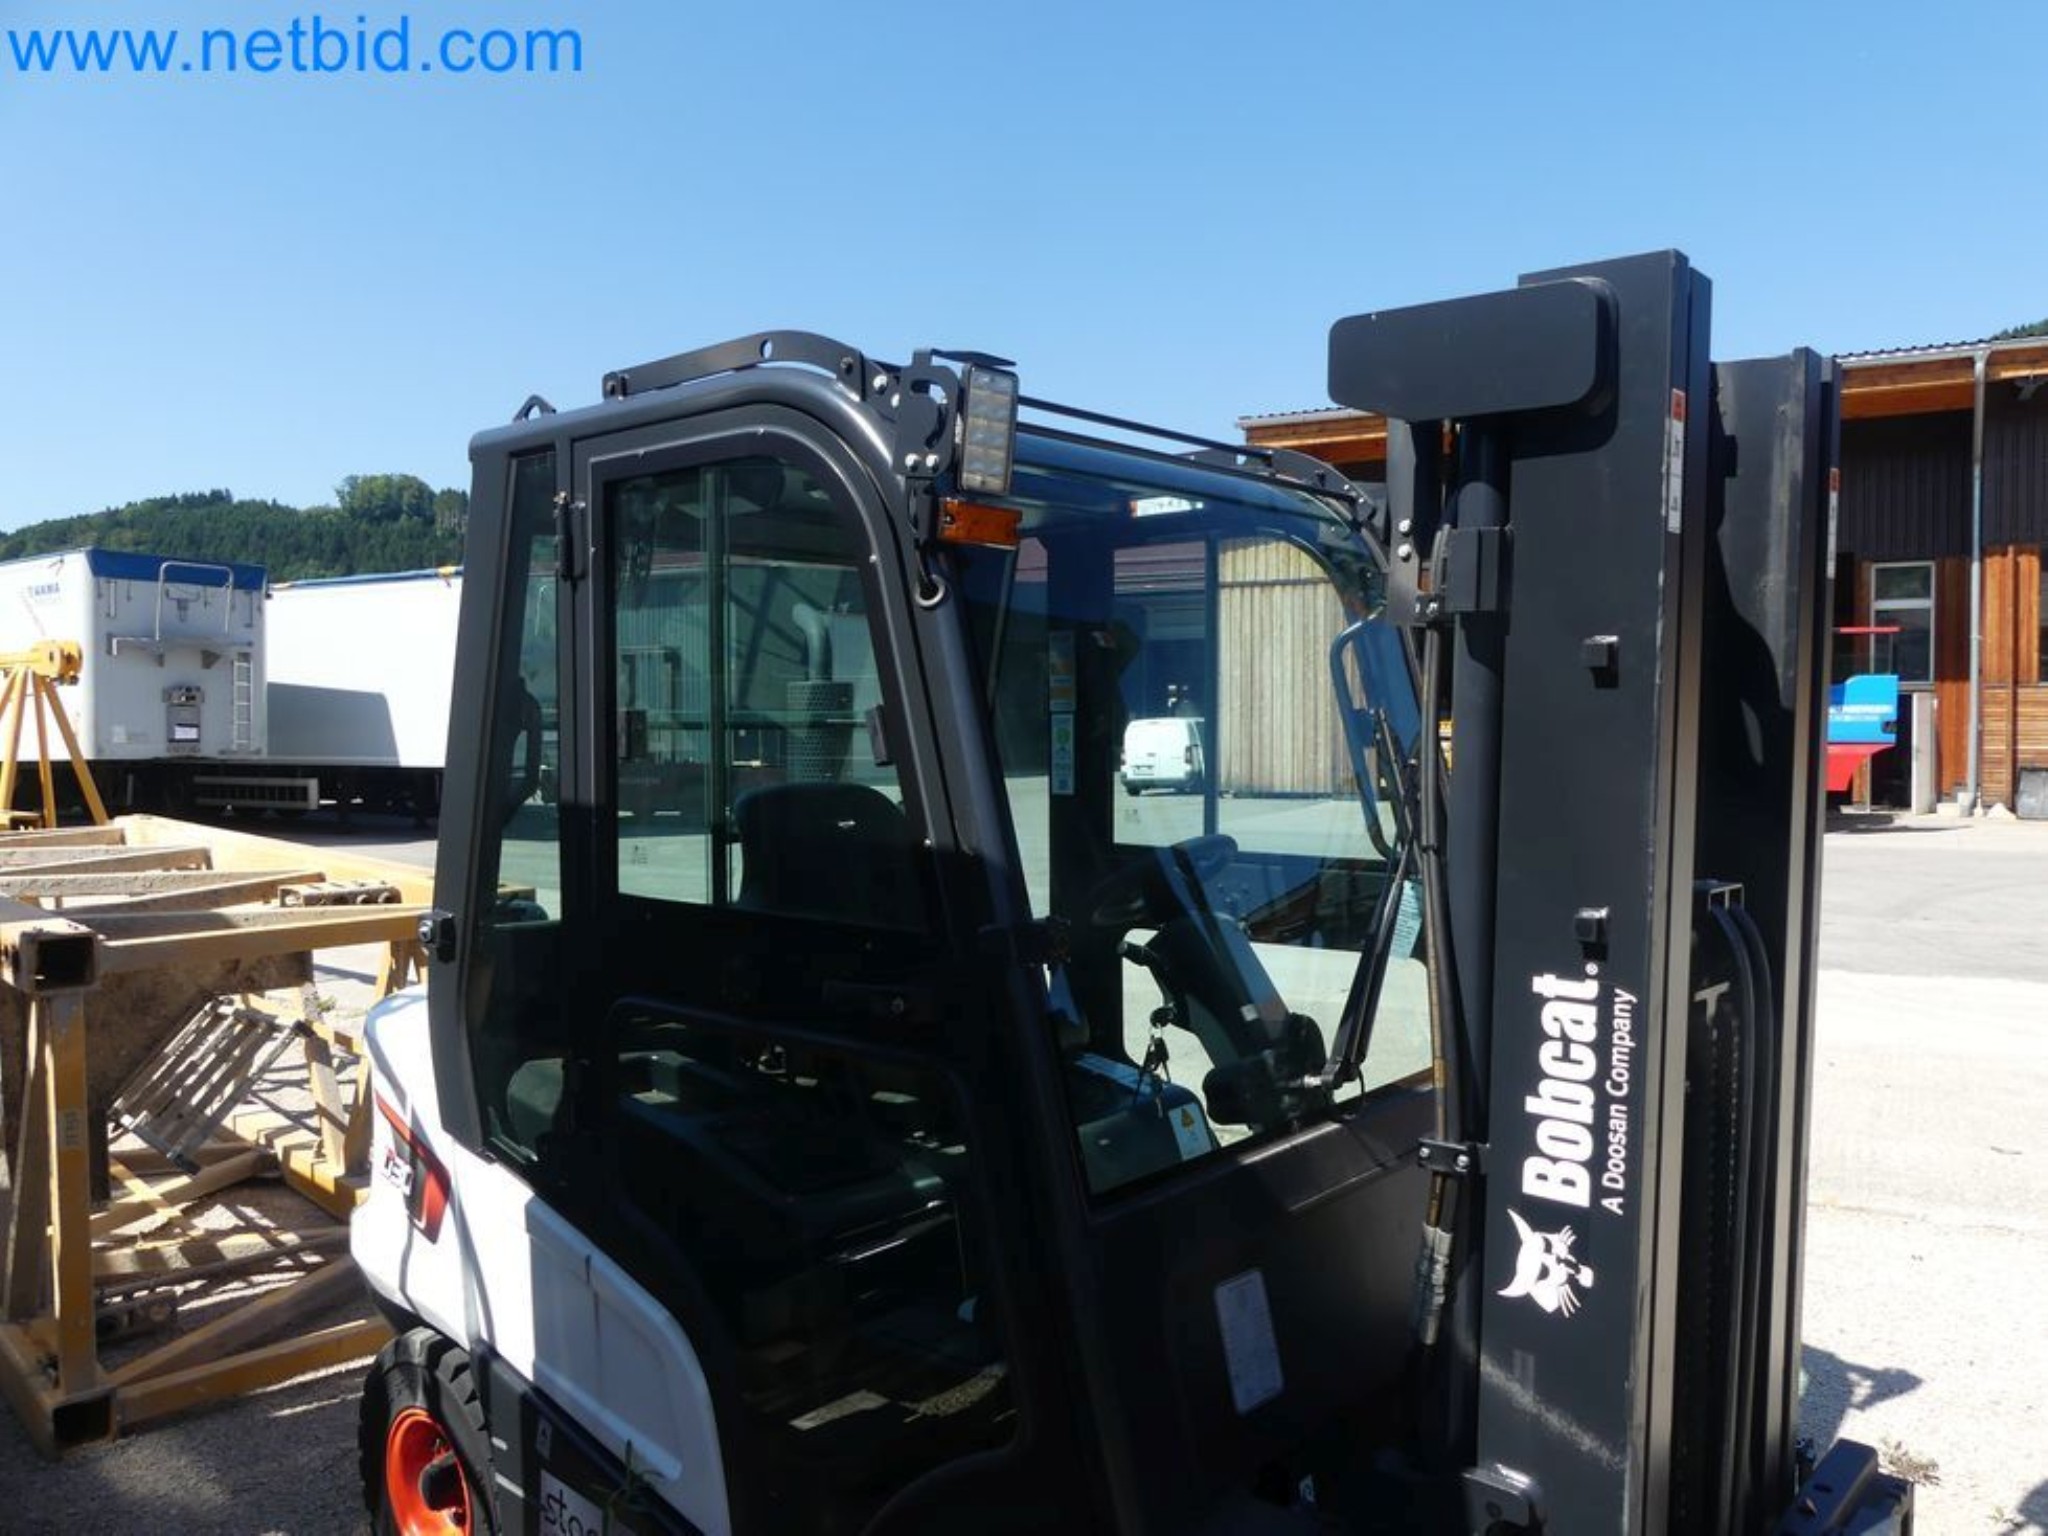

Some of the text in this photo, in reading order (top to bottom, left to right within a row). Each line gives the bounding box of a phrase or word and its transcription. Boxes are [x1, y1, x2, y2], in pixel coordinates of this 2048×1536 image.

[1521, 972, 1600, 1208] Bobcat
[1601, 988, 1638, 1216] A Doosan Company
